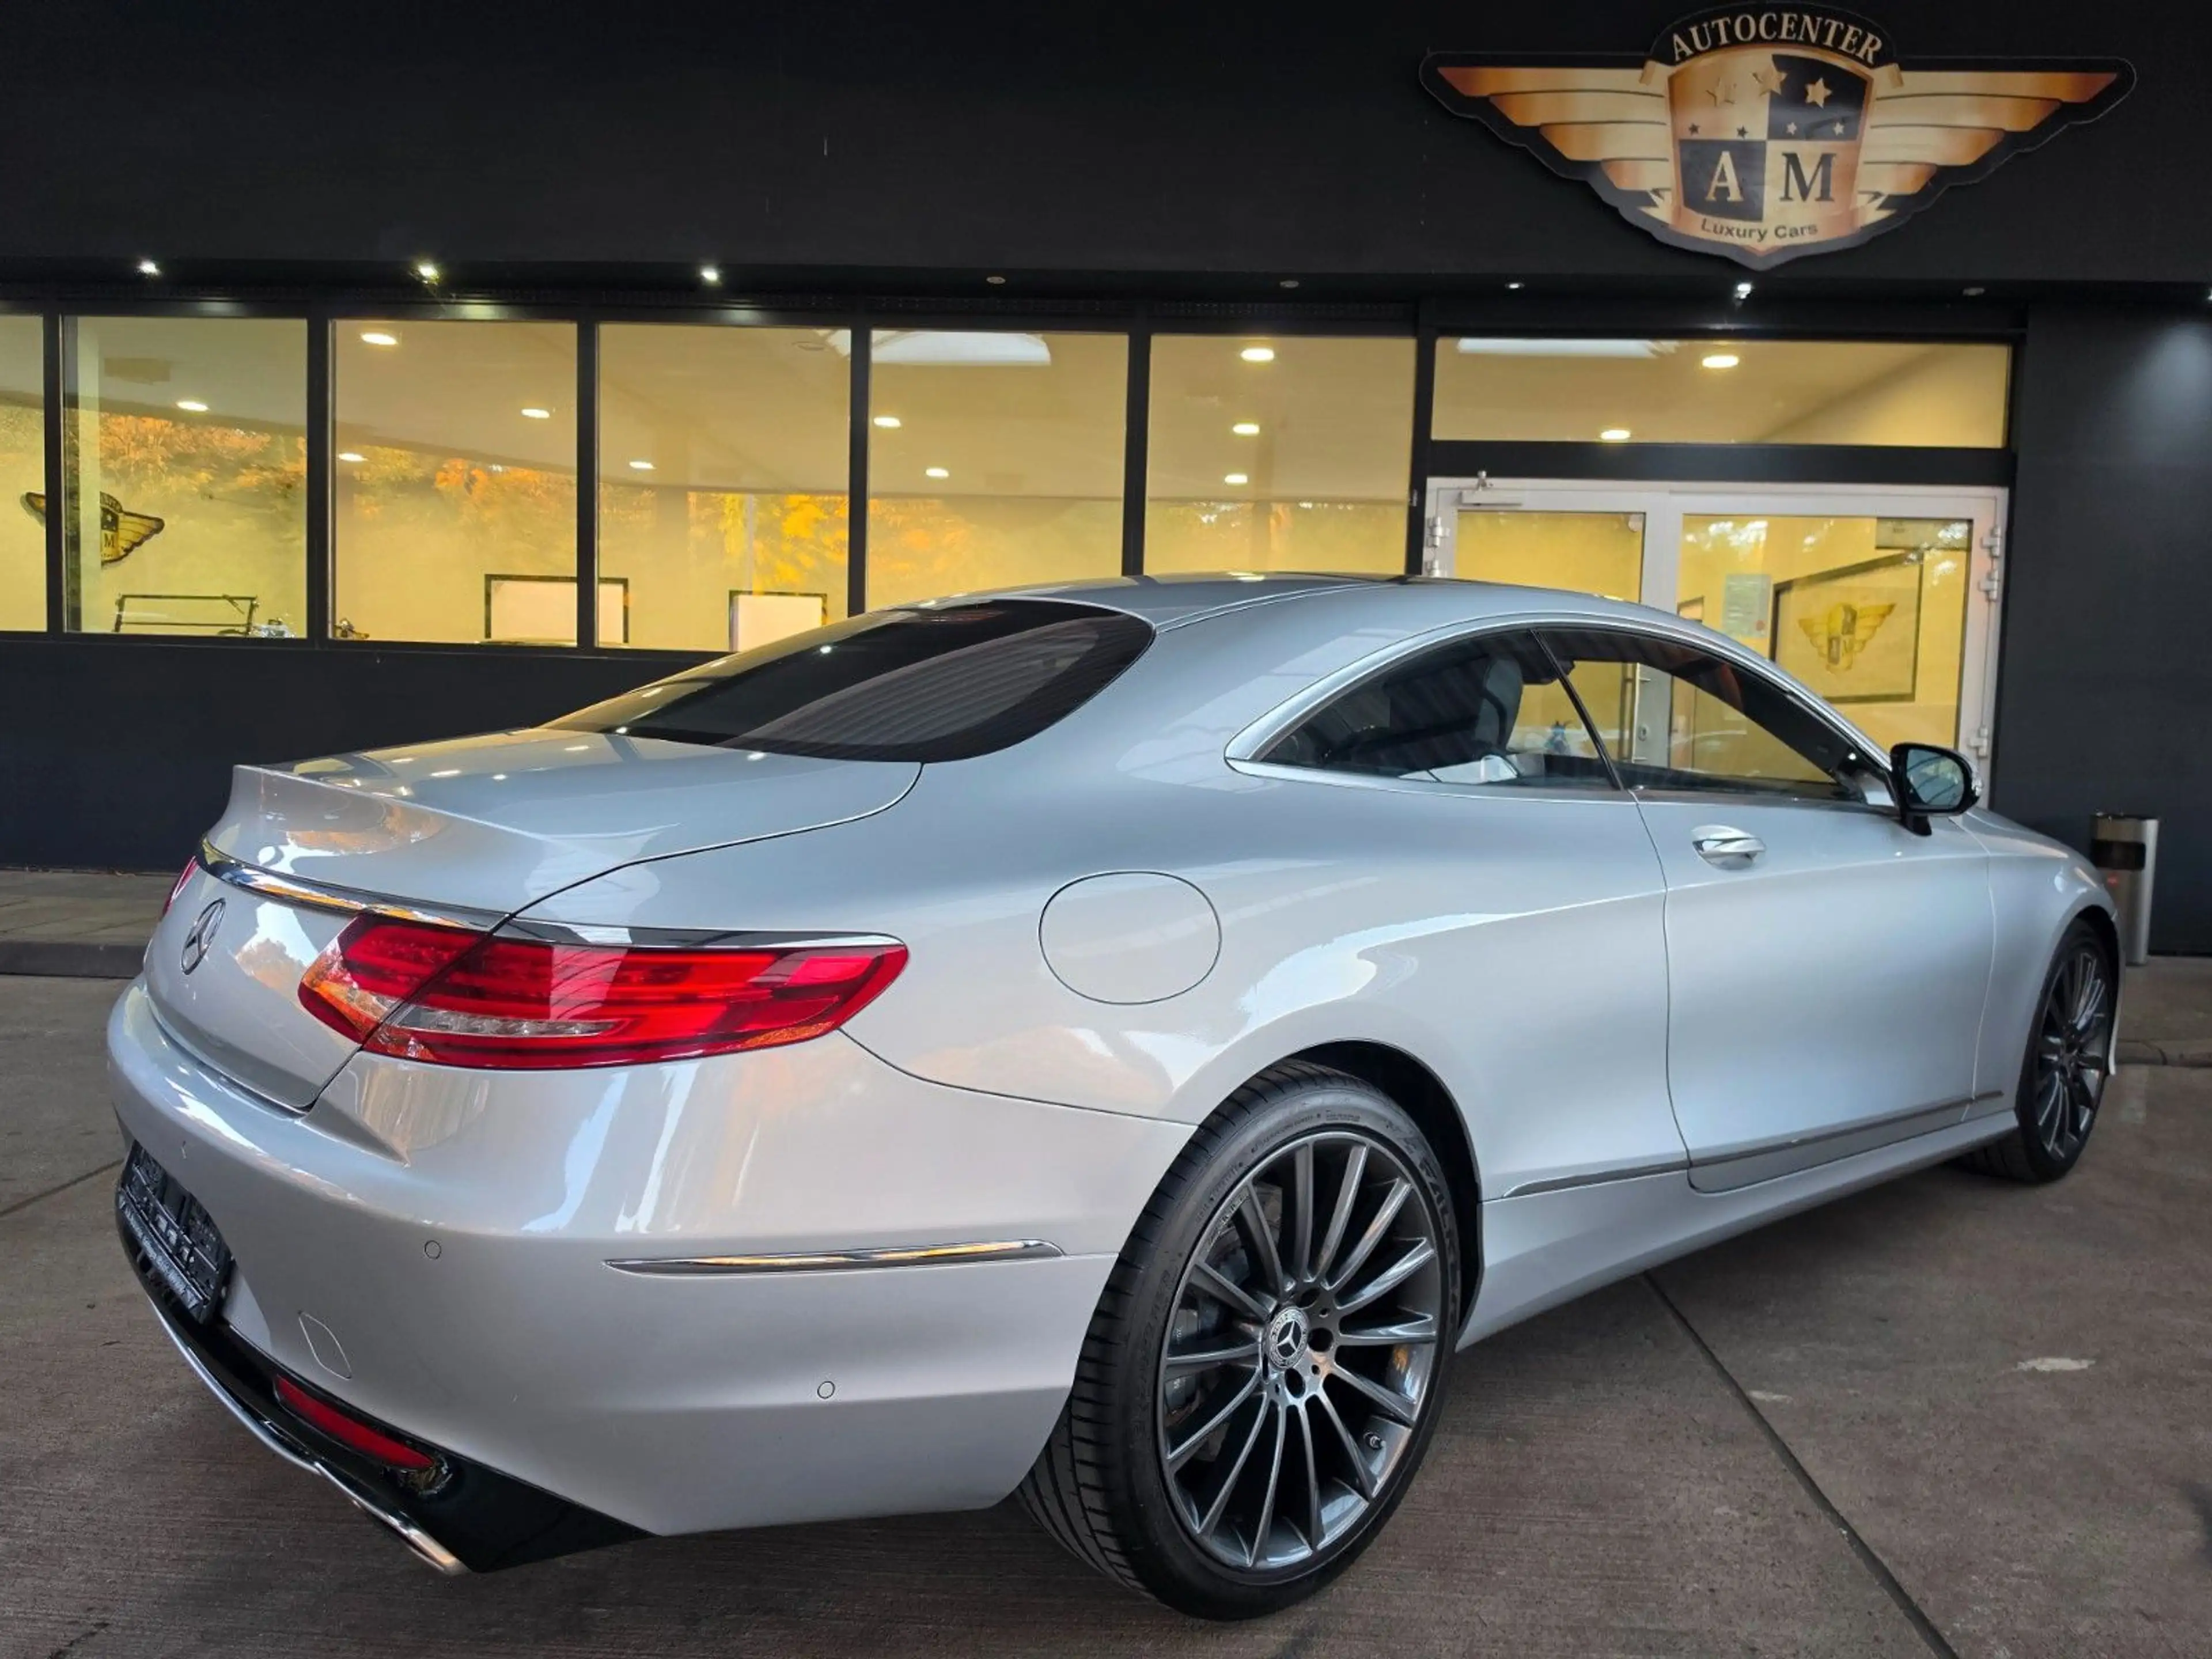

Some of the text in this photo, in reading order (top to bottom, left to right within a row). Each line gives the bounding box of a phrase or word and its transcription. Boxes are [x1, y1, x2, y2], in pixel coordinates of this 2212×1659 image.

[1672, 11, 1883, 65] AUTOCENTER
[1701, 218, 1818, 242] Luxury Cars
